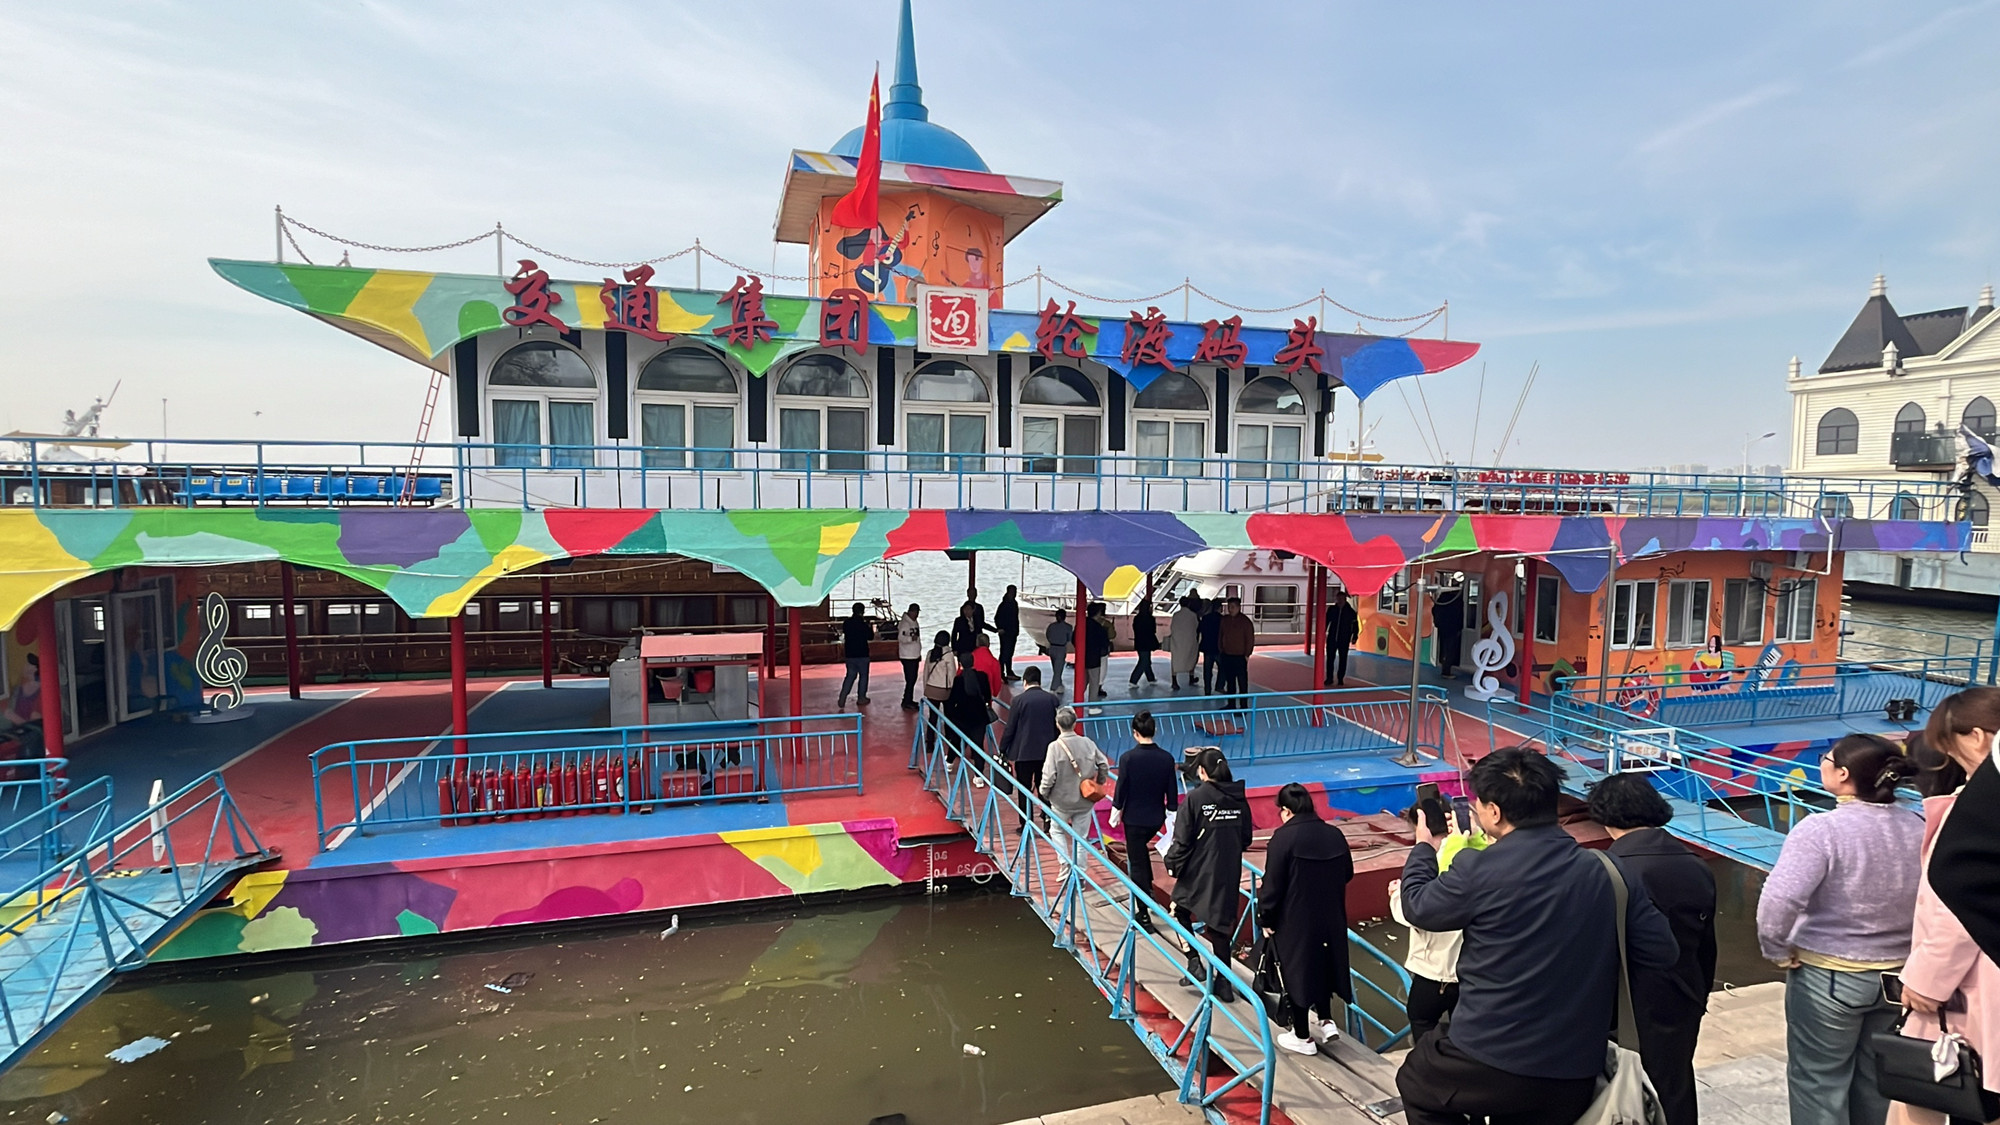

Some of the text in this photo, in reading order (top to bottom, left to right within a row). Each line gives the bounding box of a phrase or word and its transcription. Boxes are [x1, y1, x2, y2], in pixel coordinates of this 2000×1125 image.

[502, 259, 869, 356] 交通集团
[1034, 297, 1325, 375] 轮渡码头
